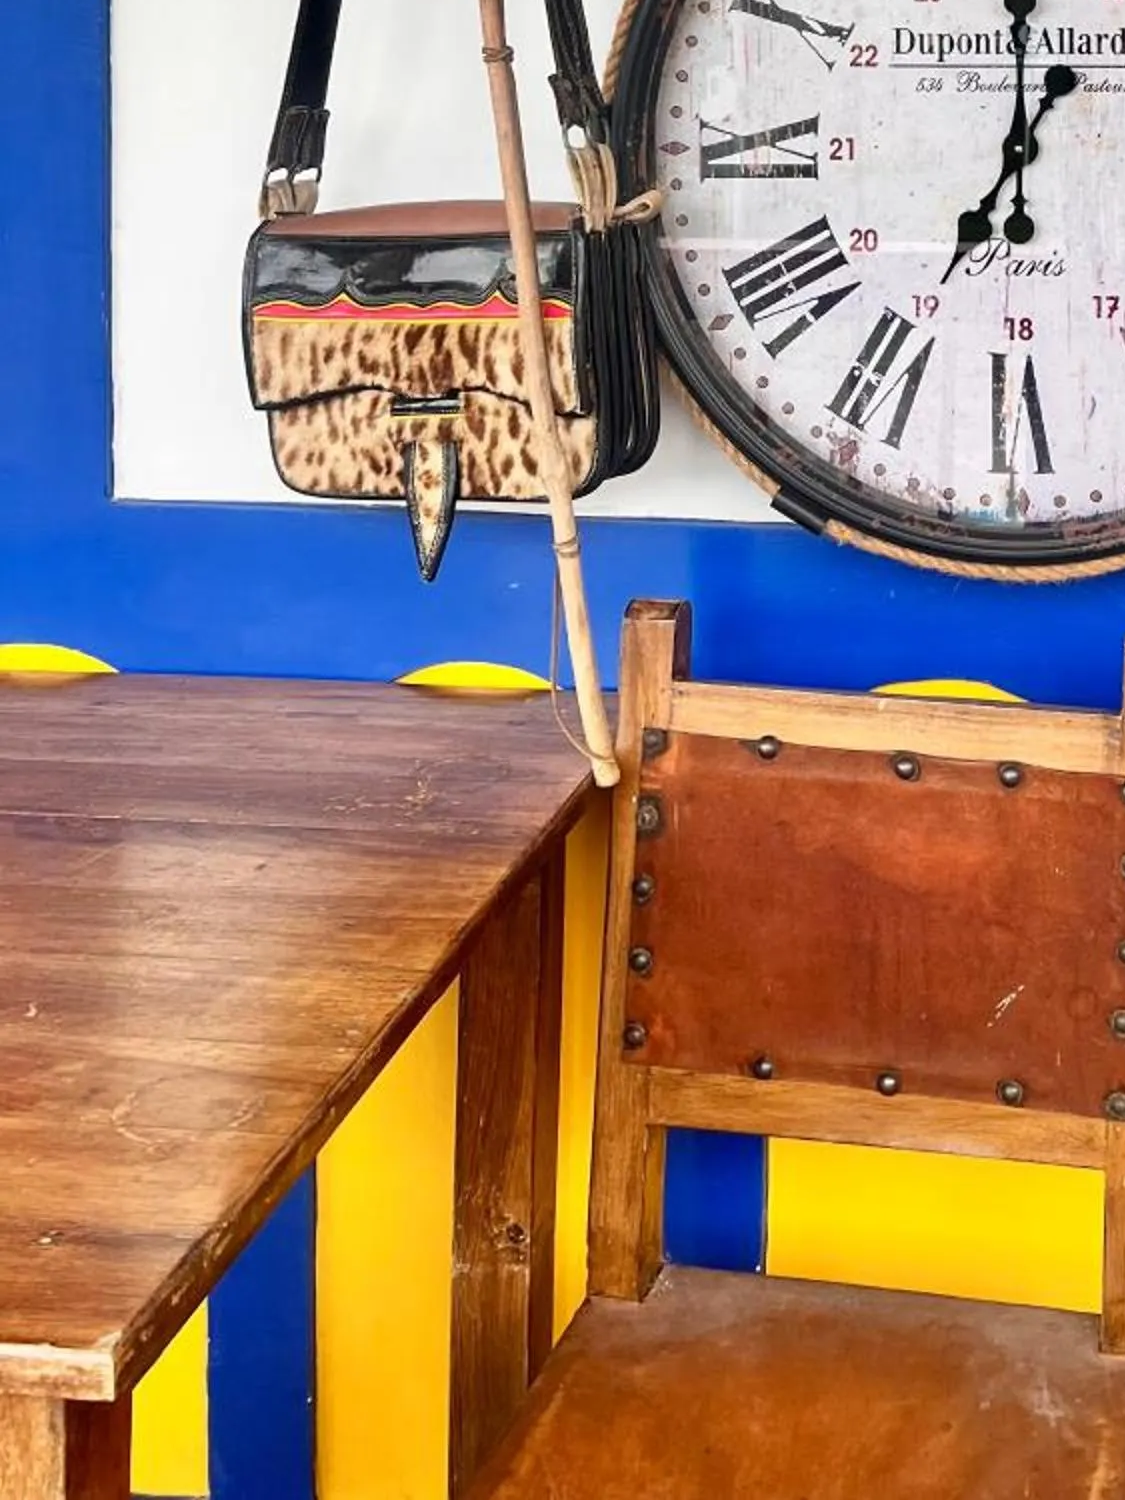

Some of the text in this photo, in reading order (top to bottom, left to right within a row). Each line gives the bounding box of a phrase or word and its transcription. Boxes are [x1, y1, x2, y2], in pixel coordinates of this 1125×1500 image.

[849, 45, 879, 67] 22
[892, 27, 1002, 62] Dupont
[699, 112, 820, 184] IX
[829, 137, 855, 161] 21
[849, 229, 878, 252] 20
[965, 238, 1066, 277] Paris
[722, 214, 862, 360] VIII
[912, 295, 939, 318] 19
[1093, 295, 1120, 319] 17
[1003, 317, 1034, 341] 18
[824, 306, 935, 450] VII
